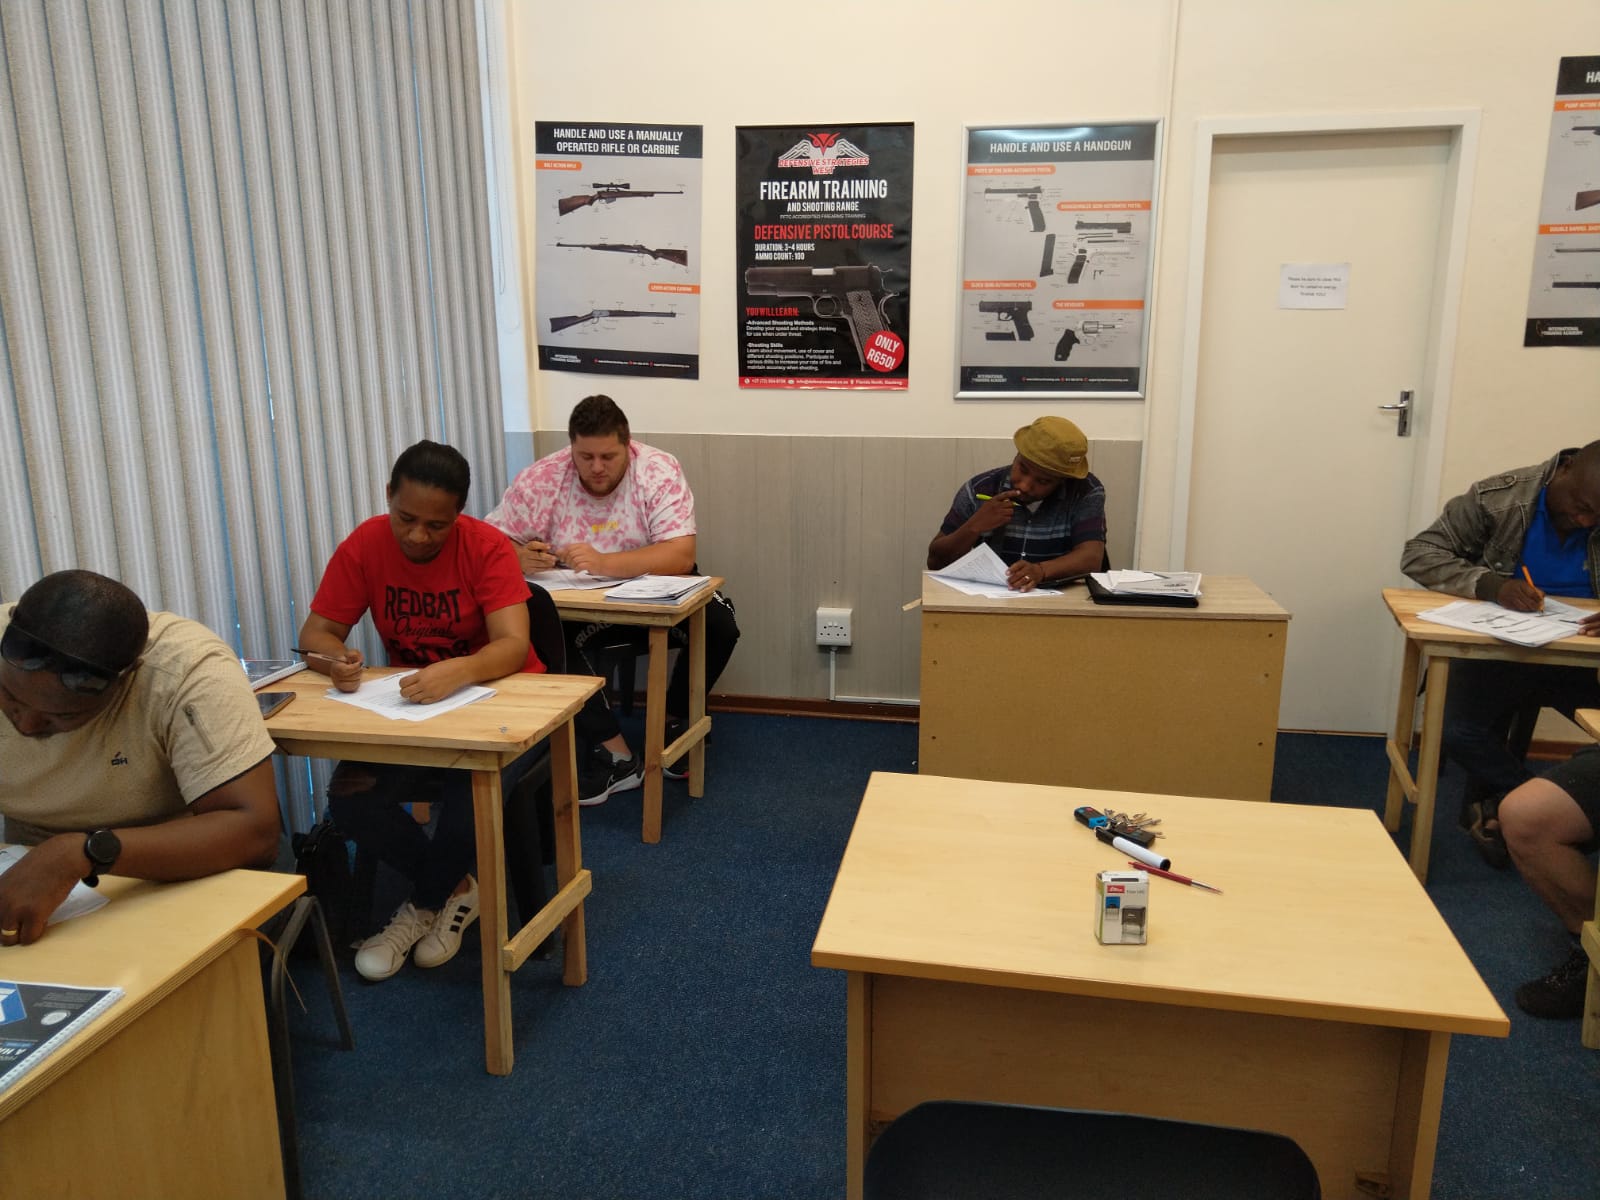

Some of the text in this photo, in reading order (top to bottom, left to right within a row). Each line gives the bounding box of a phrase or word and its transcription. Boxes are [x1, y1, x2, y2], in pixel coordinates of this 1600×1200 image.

[554, 128, 683, 142] HANDLE AND USE A MANUALLY
[556, 142, 679, 155] OPERATED RIFLE OR CARBINE
[990, 140, 1131, 153] HANDLE AND USE A HANDGUN
[779, 158, 820, 167] DEFENSIVE
[760, 180, 887, 200] FIREARM TRAINING
[787, 201, 859, 212] AND SHOOTING RANGE
[754, 224, 894, 239] DEFENSIVE PISTOL COURSE
[874, 334, 900, 353] ONLY
[866, 348, 896, 369] R650!
[384, 584, 461, 622] REDBAT
